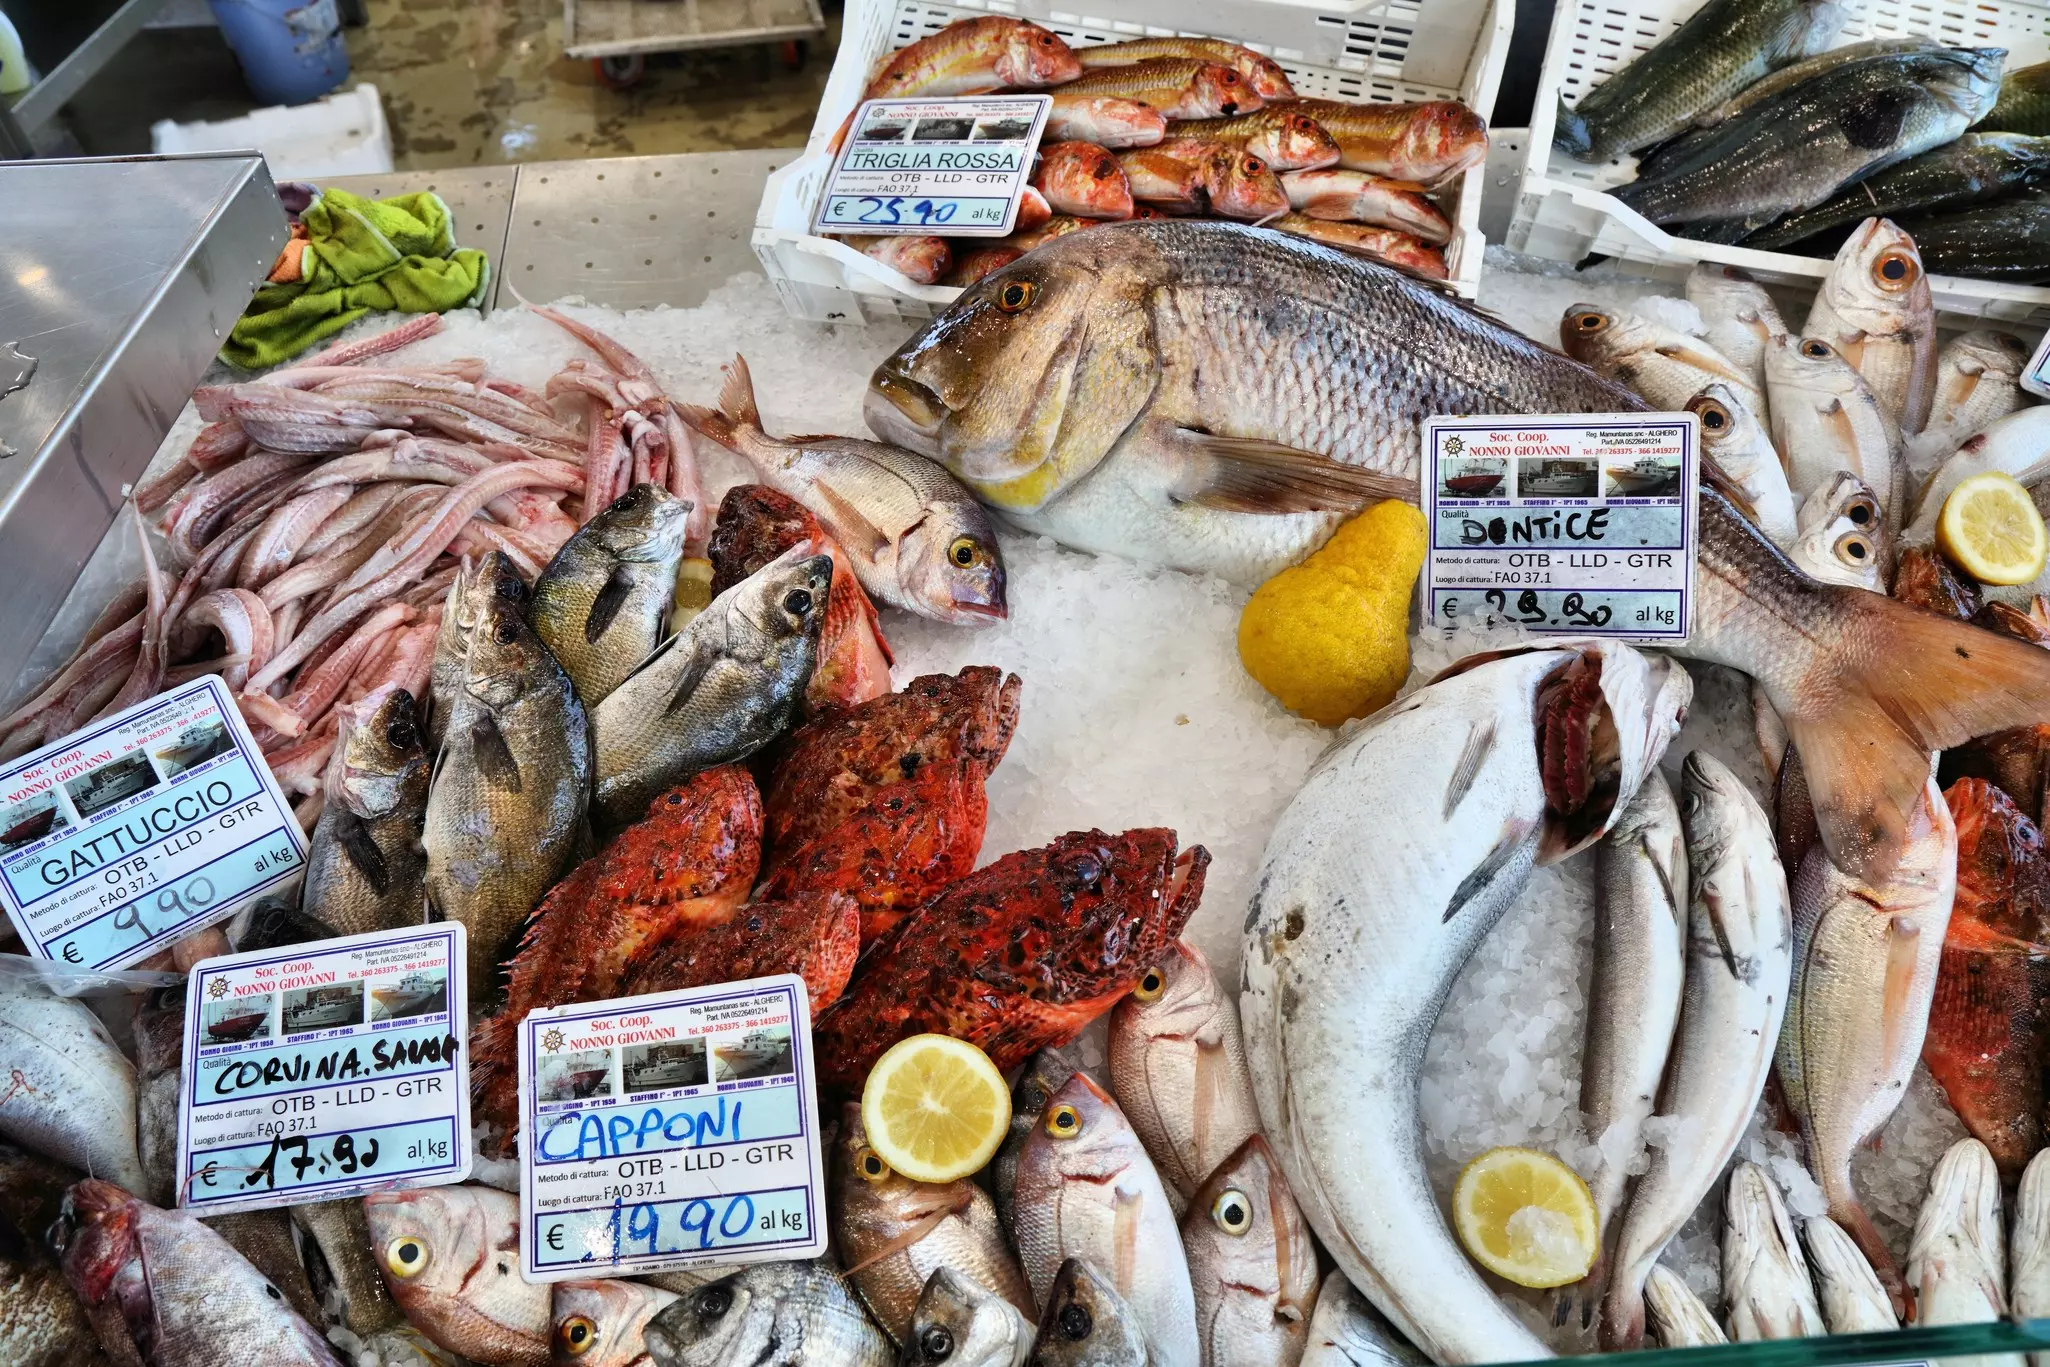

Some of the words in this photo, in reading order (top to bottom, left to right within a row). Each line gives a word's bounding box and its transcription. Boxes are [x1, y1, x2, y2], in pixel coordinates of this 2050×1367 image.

[853, 152, 931, 168] TRIGLIA
[936, 152, 1014, 169] ROSSA
[877, 184, 897, 193] FAO
[898, 184, 918, 193] 37.1
[890, 173, 921, 183] OTB
[934, 173, 962, 183] LLD
[975, 173, 1009, 183] GTR
[833, 201, 847, 216] €
[971, 208, 984, 219] al
[986, 208, 1001, 221] kg
[1489, 432, 1513, 442] Soc.
[1516, 432, 1549, 443] Coop.
[1585, 431, 1597, 439] Reg.
[1648, 429, 1678, 437] ALGHERO
[1469, 446, 1511, 456] NONNO
[1514, 445, 1570, 456] GIOVANNI
[1441, 509, 1469, 519] Qualità
[1435, 556, 1466, 564] Metodo
[1466, 556, 1472, 564] di
[1508, 553, 1550, 568] OTB
[1570, 553, 1608, 568] LLD
[1627, 553, 1672, 568] GTR
[1435, 576, 1459, 584] Luogo
[1459, 575, 1465, 583] di
[1494, 571, 1521, 583] FAO
[1524, 571, 1551, 584] 37.1
[1441, 597, 1458, 619] €
[1635, 605, 1650, 621] al
[1655, 606, 1675, 625] kg
[123, 743, 136, 751] Tel.
[135, 736, 148, 746] 360
[148, 725, 172, 741] 263375
[176, 718, 189, 728] 366
[192, 705, 215, 721] 419277
[22, 766, 49, 782] Soc.
[50, 750, 85, 769] Coop.
[7, 778, 52, 805] NONNO
[54, 750, 113, 782] GIOVANNI
[40, 781, 232, 885] GATTUCCIO
[11, 855, 42, 874] Qualità
[29, 900, 63, 920] Metodo
[61, 896, 71, 905] di
[69, 884, 98, 901] cattura:
[104, 856, 148, 884] OTB
[163, 830, 202, 857] LLD
[219, 801, 263, 829] GTR
[39, 921, 66, 938] Luogo
[64, 917, 72, 926] di
[71, 904, 101, 922] cattura:
[98, 886, 127, 907] FAO
[128, 871, 159, 893] 37.1
[62, 941, 84, 964] €
[113, 876, 216, 939] 9.90
[254, 854, 270, 872] al
[269, 847, 293, 864] kg
[254, 967, 278, 979] Soc.
[282, 961, 314, 974] Coop.
[347, 971, 357, 979] Tel.
[361, 969, 373, 977] 360
[374, 965, 398, 975] 263375
[418, 958, 446, 968] 1419277
[234, 981, 276, 997] NONNO
[279, 971, 335, 990] GIOVANNI
[689, 1007, 702, 1016] Reg.
[753, 994, 783, 1005] ALGHERO
[730, 1006, 768, 1018] 05226491214
[591, 1020, 616, 1032] Soc.
[619, 1015, 653, 1028] Coop.
[688, 1027, 700, 1035] Tel.
[702, 1025, 714, 1034] 360
[715, 1021, 740, 1032] 263375
[746, 1019, 759, 1028] 366
[759, 1015, 788, 1026] 1419277
[570, 1035, 614, 1050] NONNO
[617, 1026, 675, 1044] GIOVANNI
[202, 1056, 232, 1070] Qualità
[194, 1112, 227, 1123] Metodo
[226, 1110, 233, 1119] di
[233, 1108, 263, 1118] cattura:
[272, 1095, 315, 1115] OTB
[336, 1086, 375, 1106] LLD
[396, 1077, 442, 1097] GTR
[194, 1136, 217, 1146] Luogo
[218, 1133, 225, 1142] di
[226, 1131, 255, 1141] cattura:
[257, 1120, 285, 1136] FAO
[288, 1115, 317, 1132] 37.1
[539, 1095, 742, 1162] CAPPONI
[199, 1160, 219, 1187] €
[407, 1139, 422, 1159] al
[428, 1138, 448, 1159] kg
[538, 1172, 569, 1183] Metodo
[569, 1171, 578, 1180] di
[578, 1170, 609, 1179] cattura:
[618, 1158, 664, 1179] OTB
[684, 1151, 725, 1172] LLD
[745, 1143, 794, 1164] GTR
[538, 1198, 562, 1208] Luogo
[563, 1195, 571, 1204] di
[572, 1194, 602, 1203] cattura:
[604, 1184, 632, 1200] FAO
[636, 1180, 666, 1197] 37.1
[546, 1223, 564, 1251] €
[760, 1210, 776, 1230] al
[781, 1208, 802, 1231] kg
